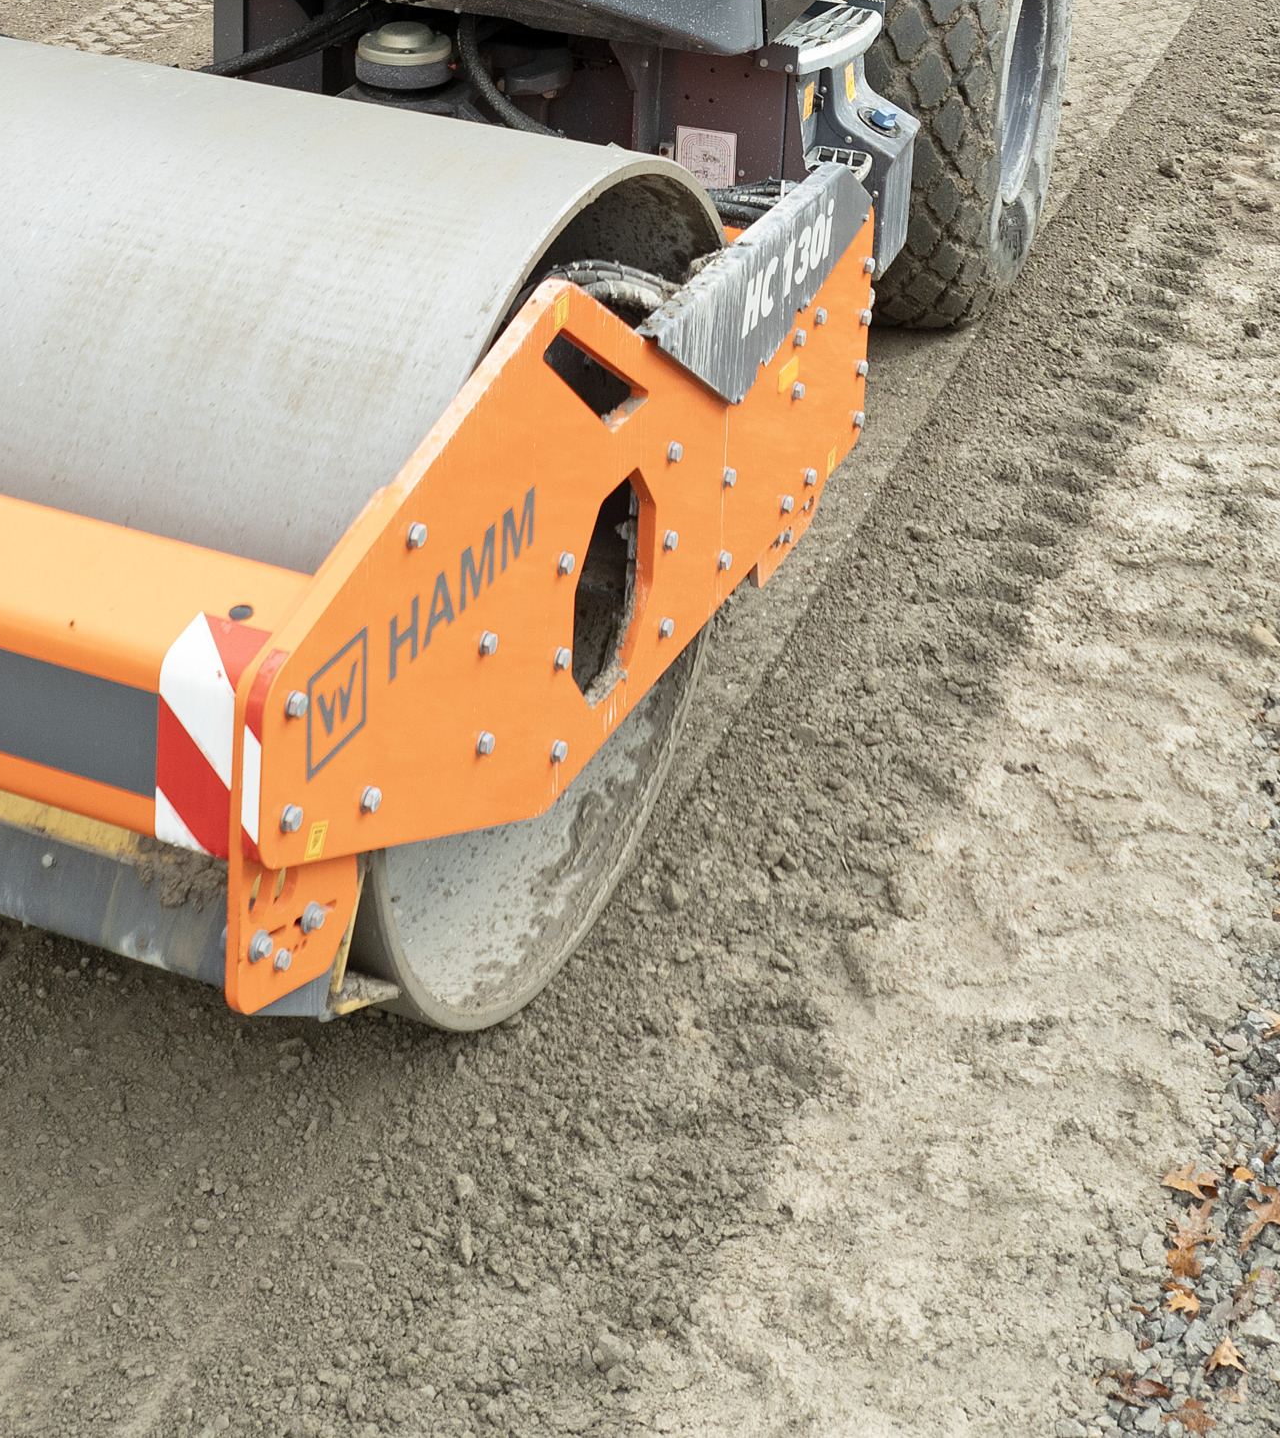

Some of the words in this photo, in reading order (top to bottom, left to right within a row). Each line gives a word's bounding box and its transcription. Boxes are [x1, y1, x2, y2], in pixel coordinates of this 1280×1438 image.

[741, 256, 779, 340] HC
[783, 198, 835, 299] 130i
[388, 485, 536, 685] HAMM
